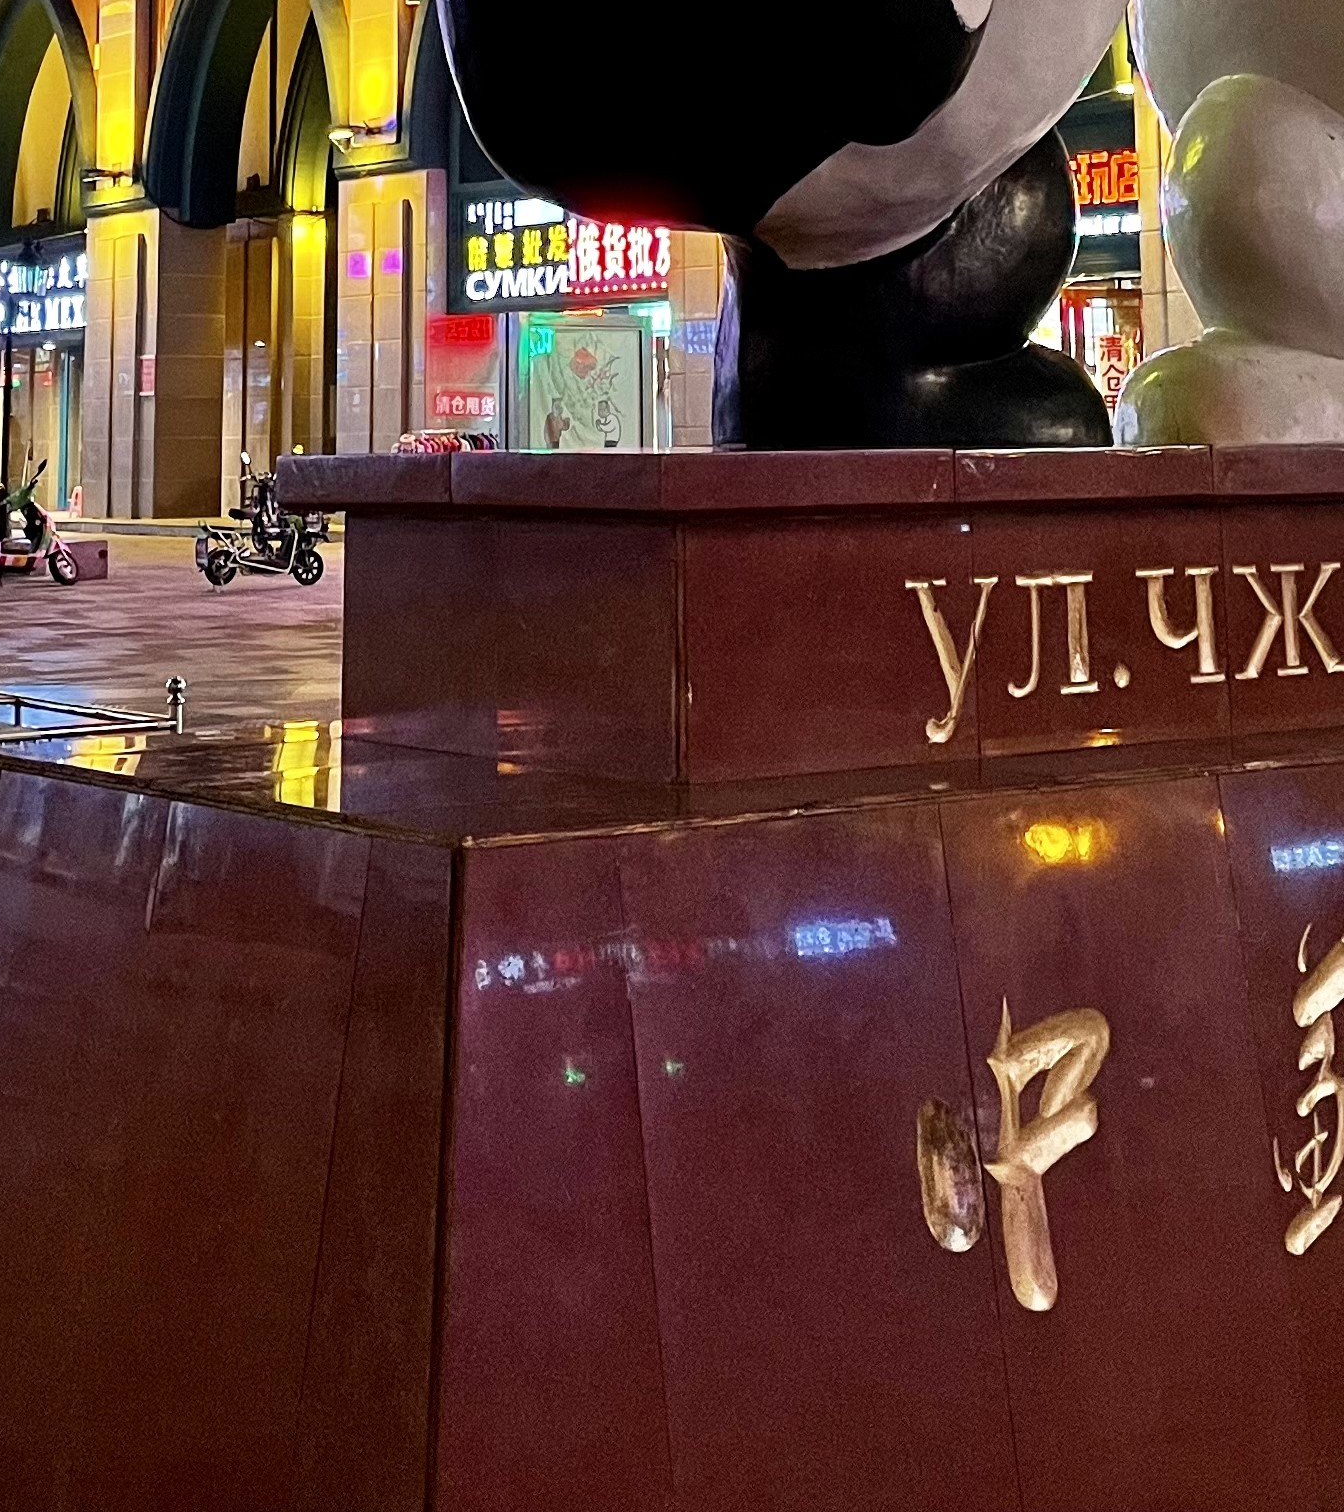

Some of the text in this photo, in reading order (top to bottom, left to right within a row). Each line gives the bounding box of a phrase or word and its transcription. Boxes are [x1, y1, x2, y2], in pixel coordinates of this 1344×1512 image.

[1069, 150, 1140, 205] 玩店
[465, 264, 571, 301] СУМКИ
[436, 396, 495, 417] 清仓甩货
